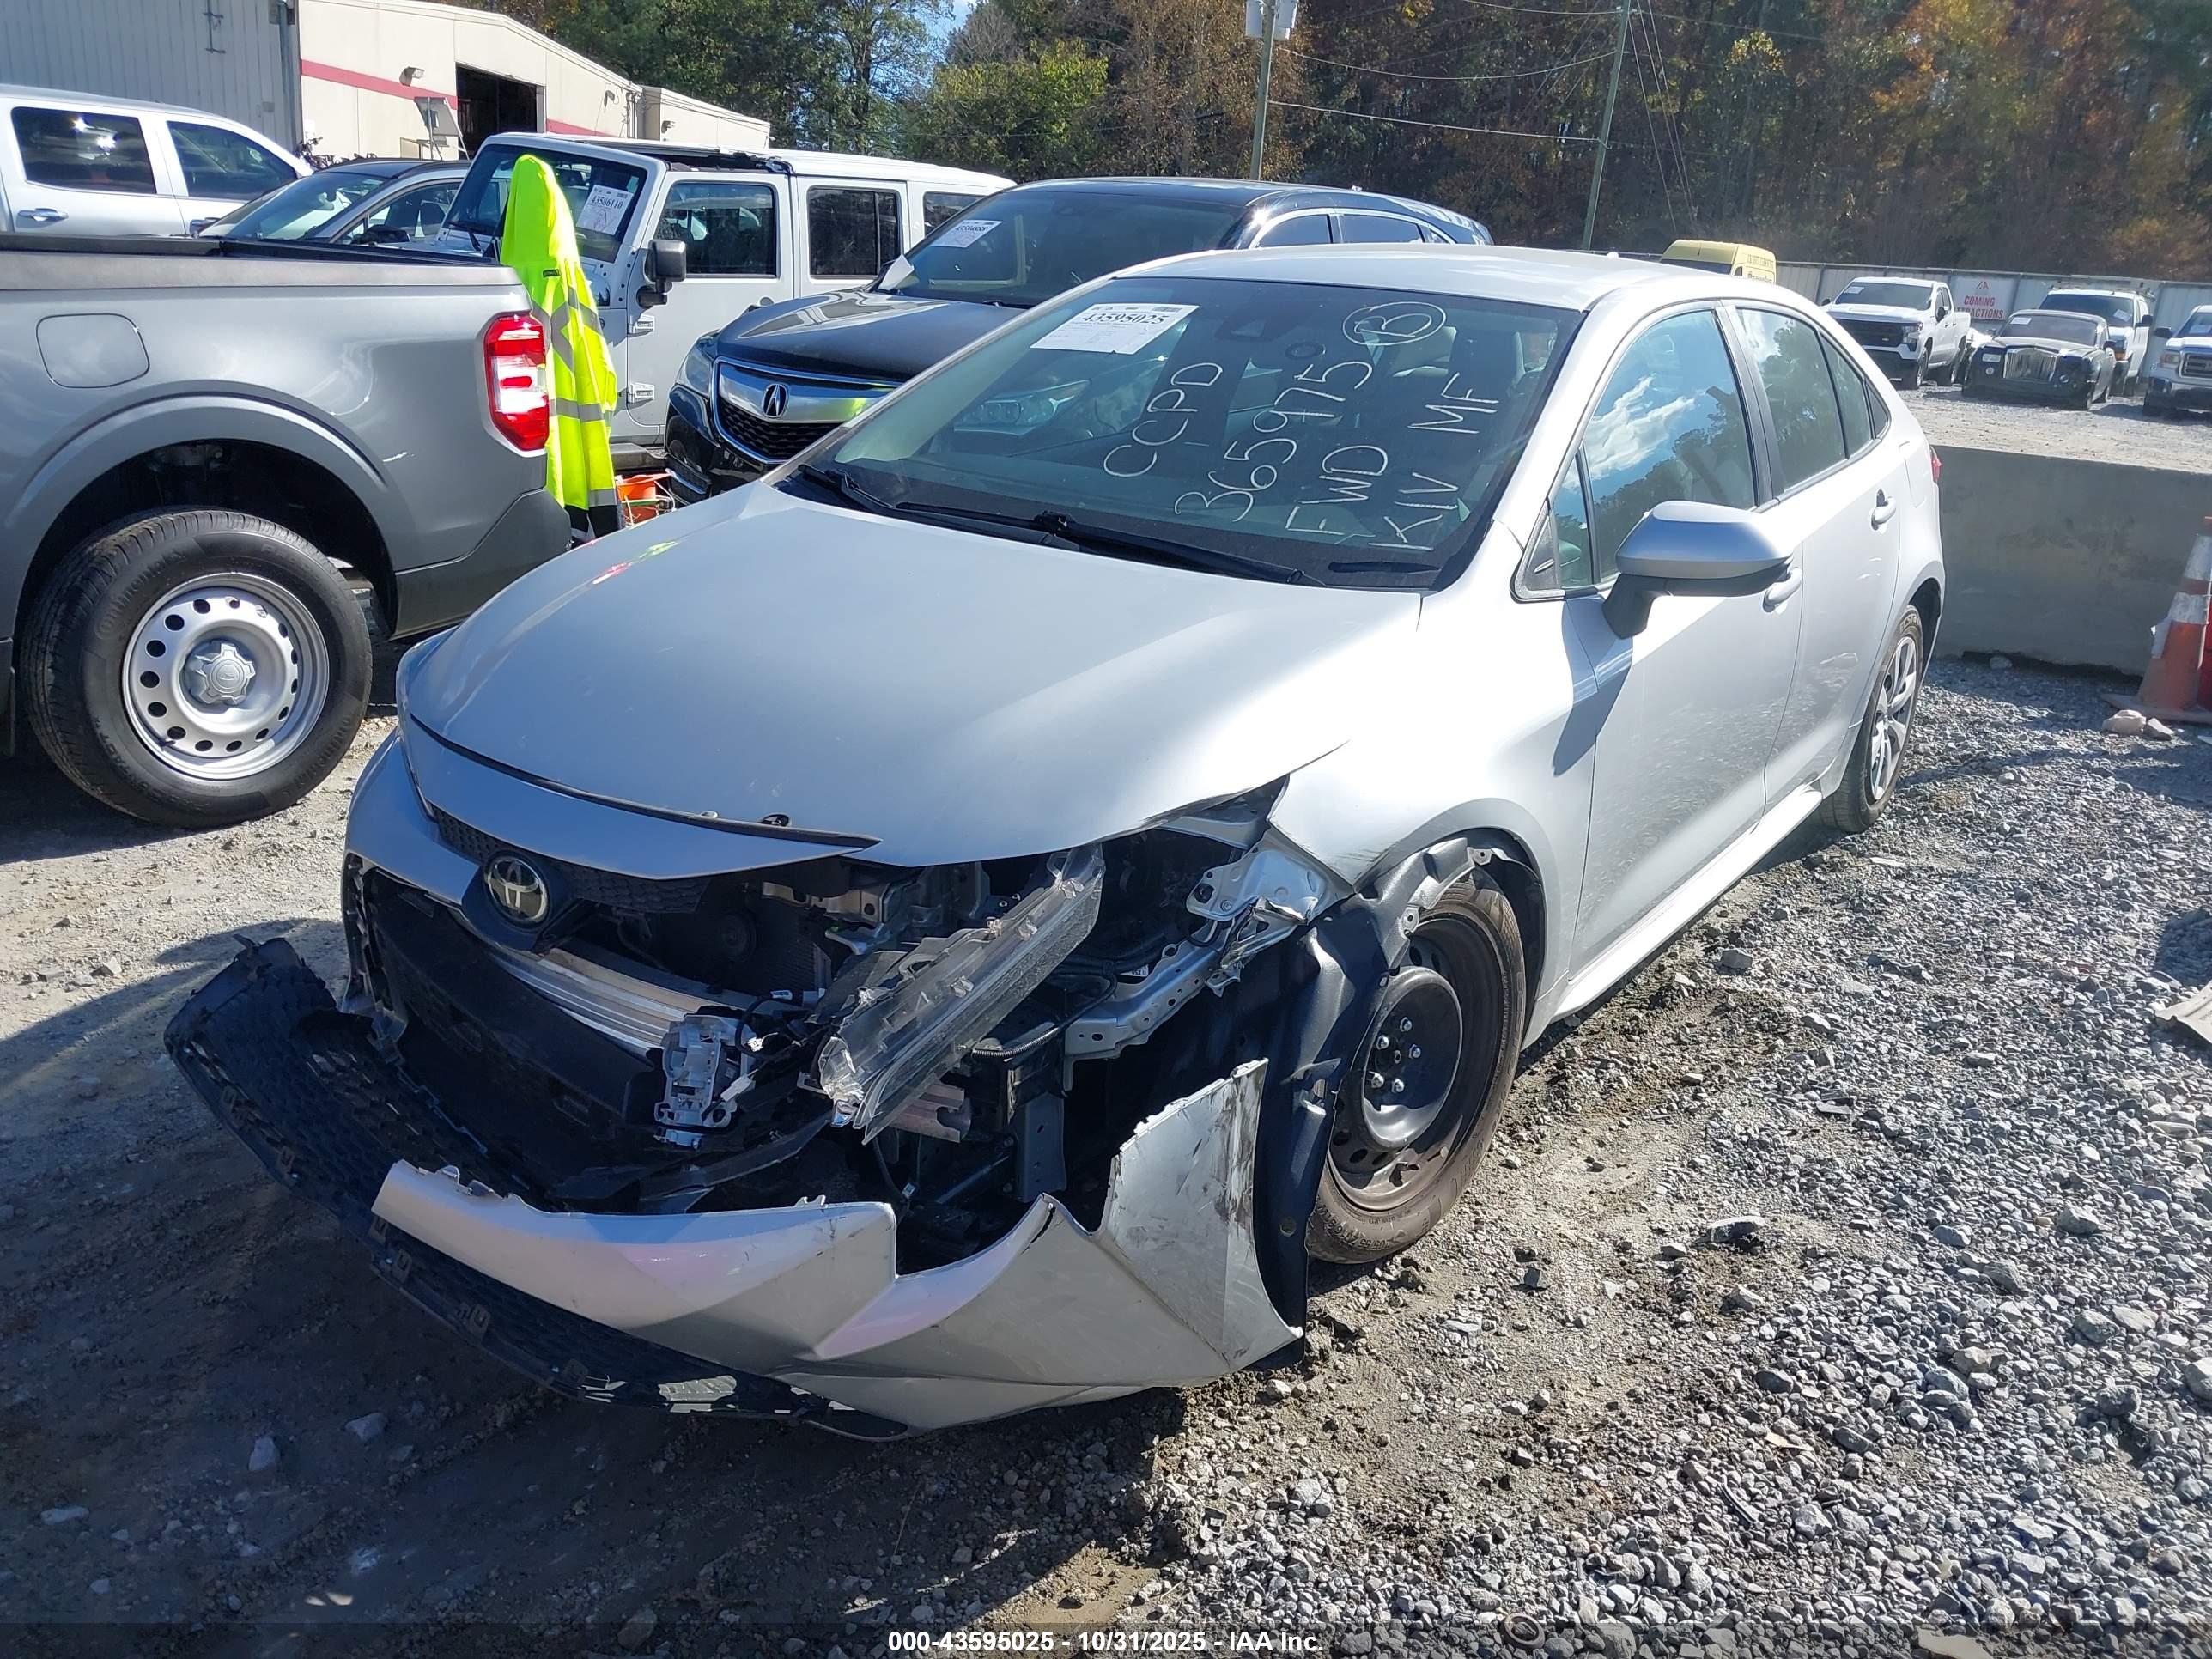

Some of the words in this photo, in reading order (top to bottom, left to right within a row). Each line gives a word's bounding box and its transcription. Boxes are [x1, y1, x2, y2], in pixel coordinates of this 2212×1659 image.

[1082, 313, 1170, 324] 43595025
[1964, 295, 1996, 307] COMING
[1103, 362, 1223, 477] CCPD
[1407, 372, 1500, 434] MF
[1286, 445, 1388, 536] FWD
